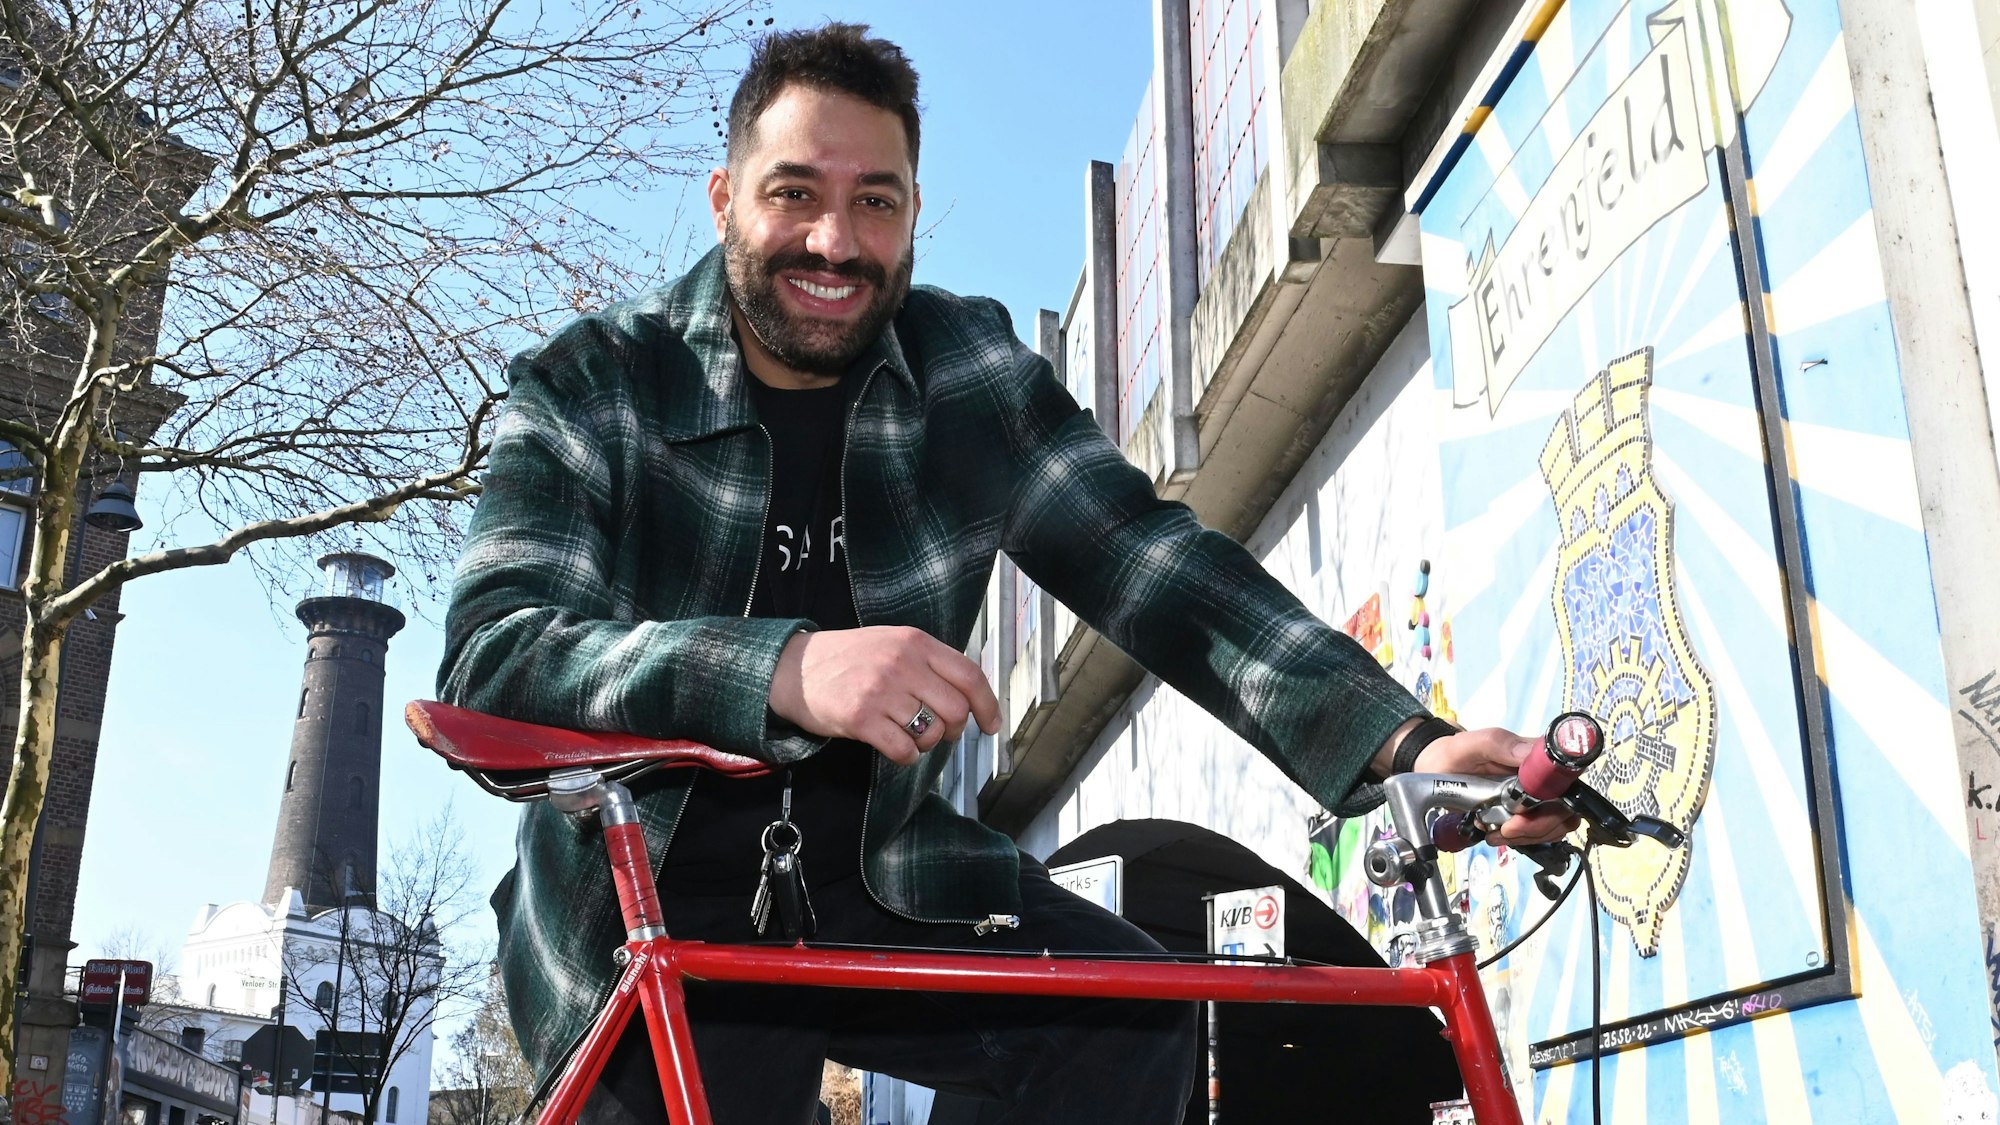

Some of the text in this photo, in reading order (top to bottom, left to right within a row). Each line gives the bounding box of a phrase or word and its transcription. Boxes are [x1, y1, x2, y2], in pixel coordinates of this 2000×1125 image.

[1481, 54, 1685, 367] Ehrenfeld
[1060, 875, 1098, 890] irks-
[1220, 906, 1252, 928] KVB
[241, 979, 265, 988] Venloer
[619, 952, 648, 993] Bianchi
